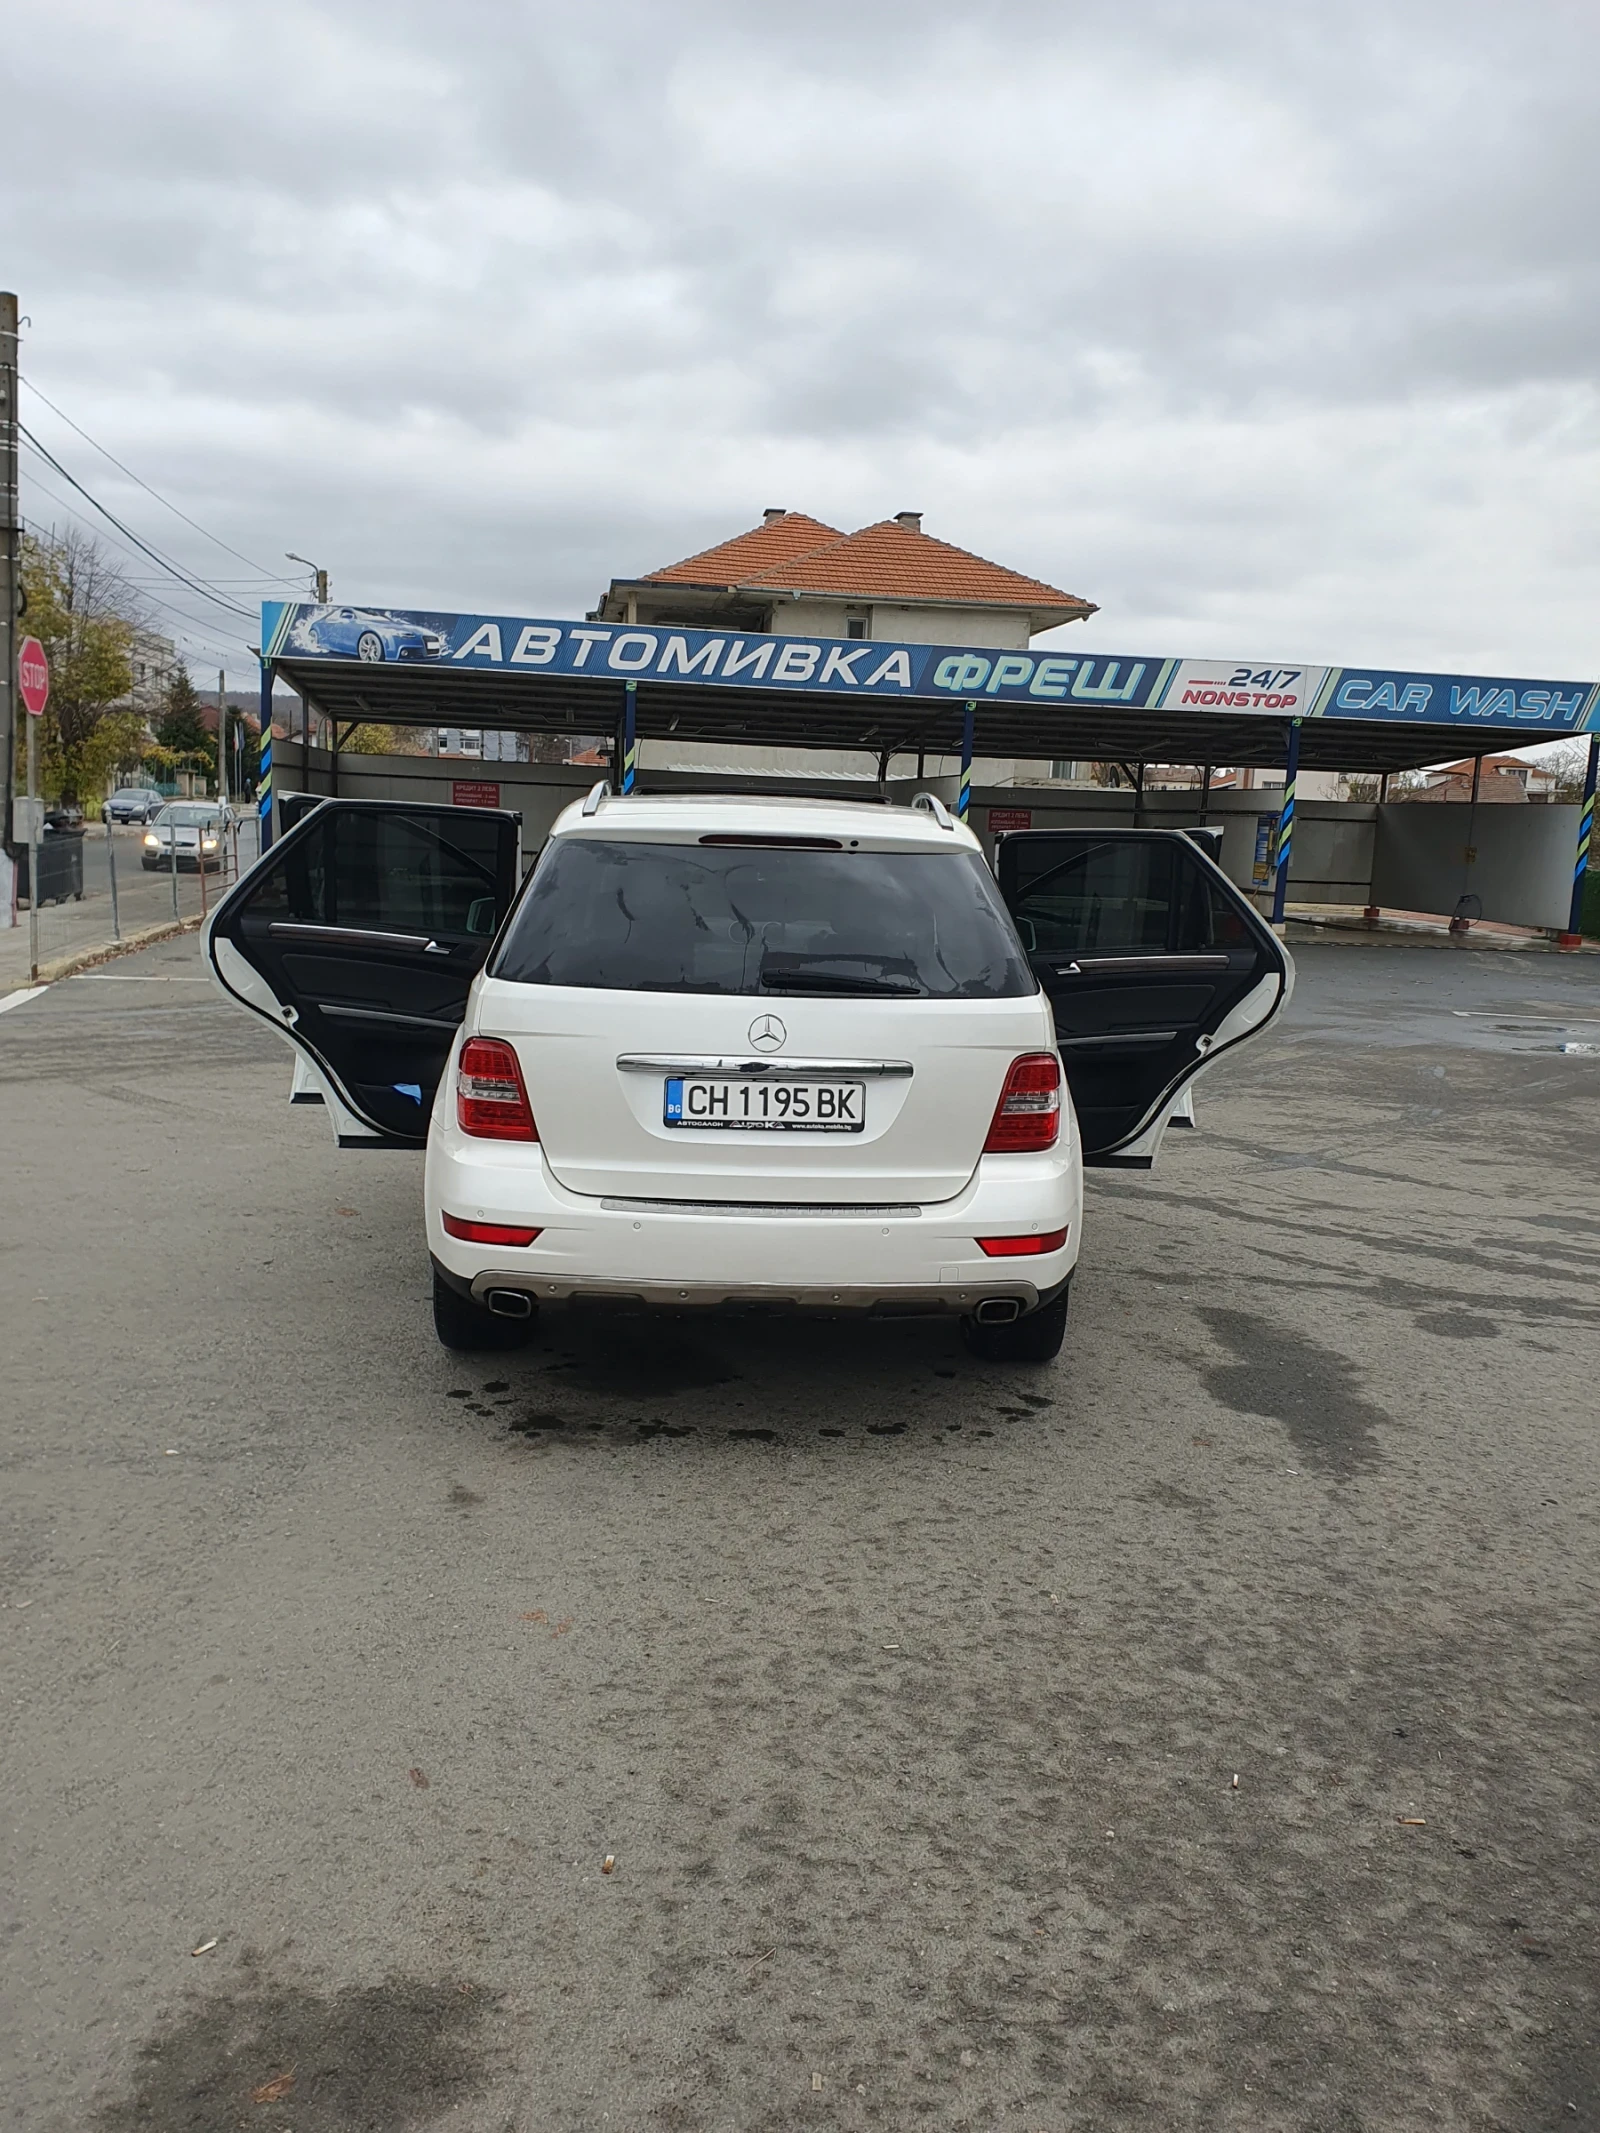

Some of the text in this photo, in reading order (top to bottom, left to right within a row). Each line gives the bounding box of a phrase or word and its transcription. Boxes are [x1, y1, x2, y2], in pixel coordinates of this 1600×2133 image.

[22, 661, 45, 690] STOP
[452, 623, 1146, 701] АВТОМИВКА ФРЕШ
[1228, 668, 1302, 691] 24/7
[1181, 689, 1298, 709] NONSTOP
[1336, 679, 1583, 721] CAR WASH
[667, 1104, 681, 1114] BG
[688, 1085, 856, 1119] CH 1195 BK
